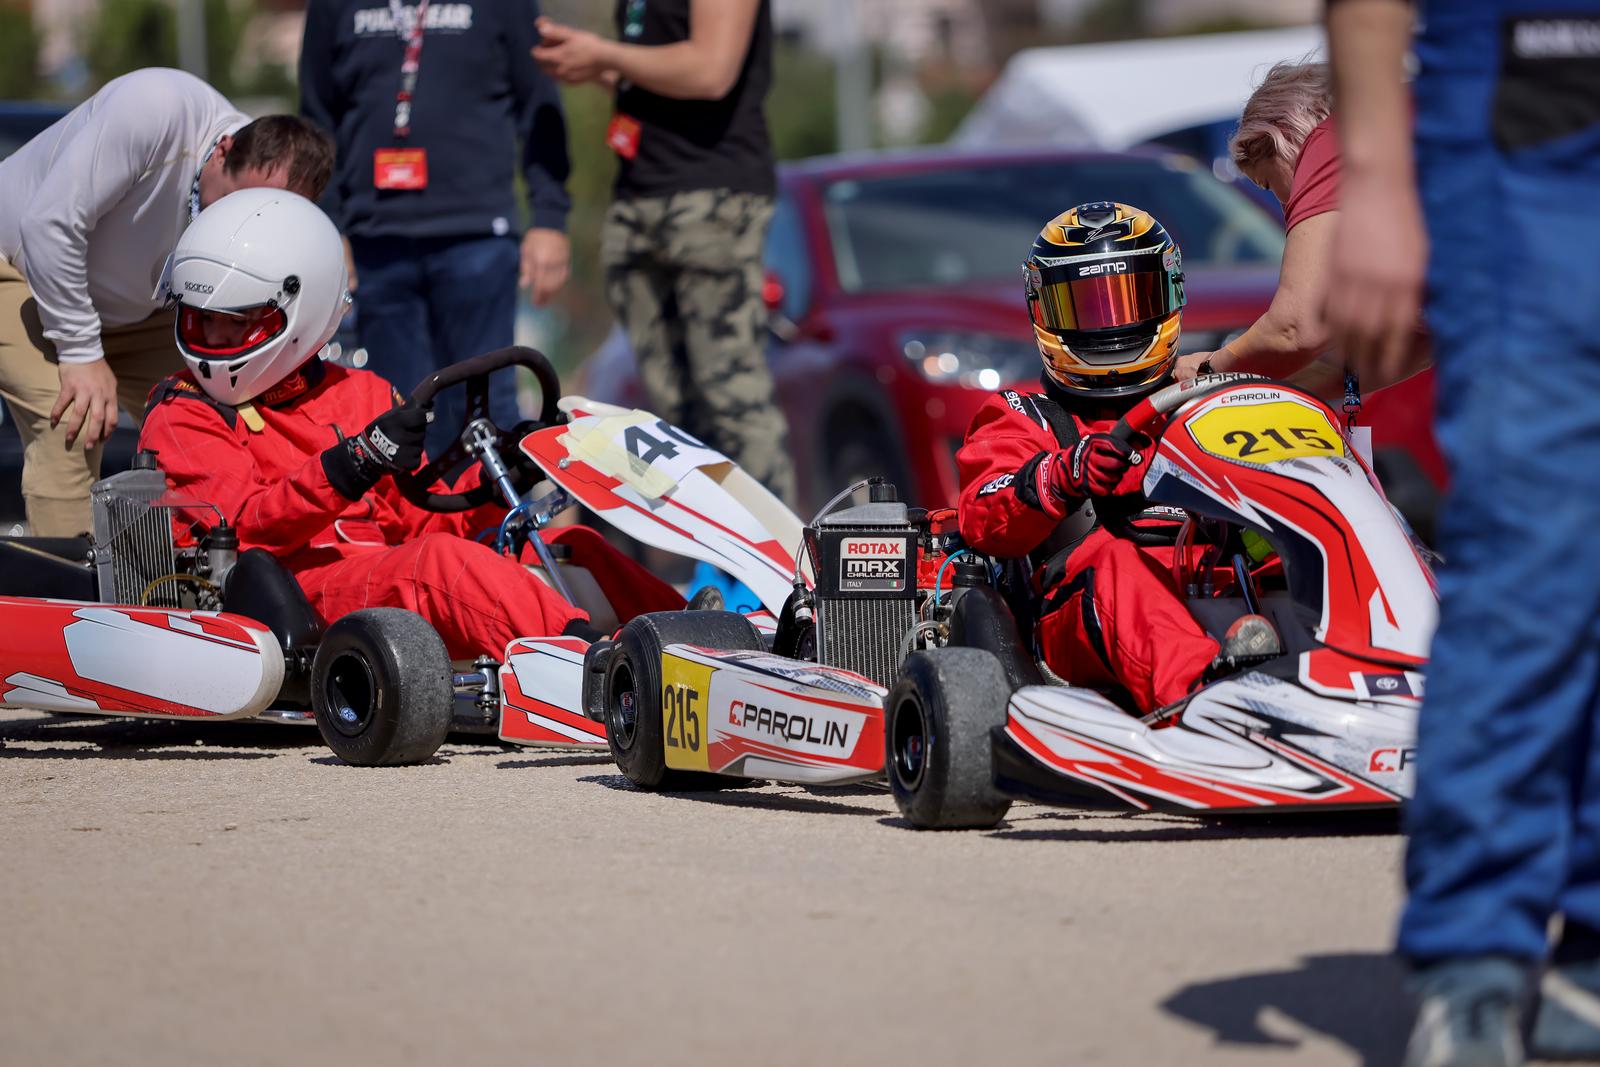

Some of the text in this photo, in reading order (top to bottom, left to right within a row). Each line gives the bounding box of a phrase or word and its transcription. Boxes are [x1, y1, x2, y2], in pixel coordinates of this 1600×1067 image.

[1079, 261, 1127, 276] zamp
[184, 281, 214, 294] sparco
[1195, 373, 1271, 386] PARO
[1230, 392, 1281, 403] PAROLIN
[369, 426, 399, 461] OMP
[1223, 427, 1335, 457] 215
[847, 543, 900, 555] ROTAX
[847, 560, 900, 573] MAX
[663, 685, 700, 753] 215
[742, 703, 849, 749] PAROLIN
